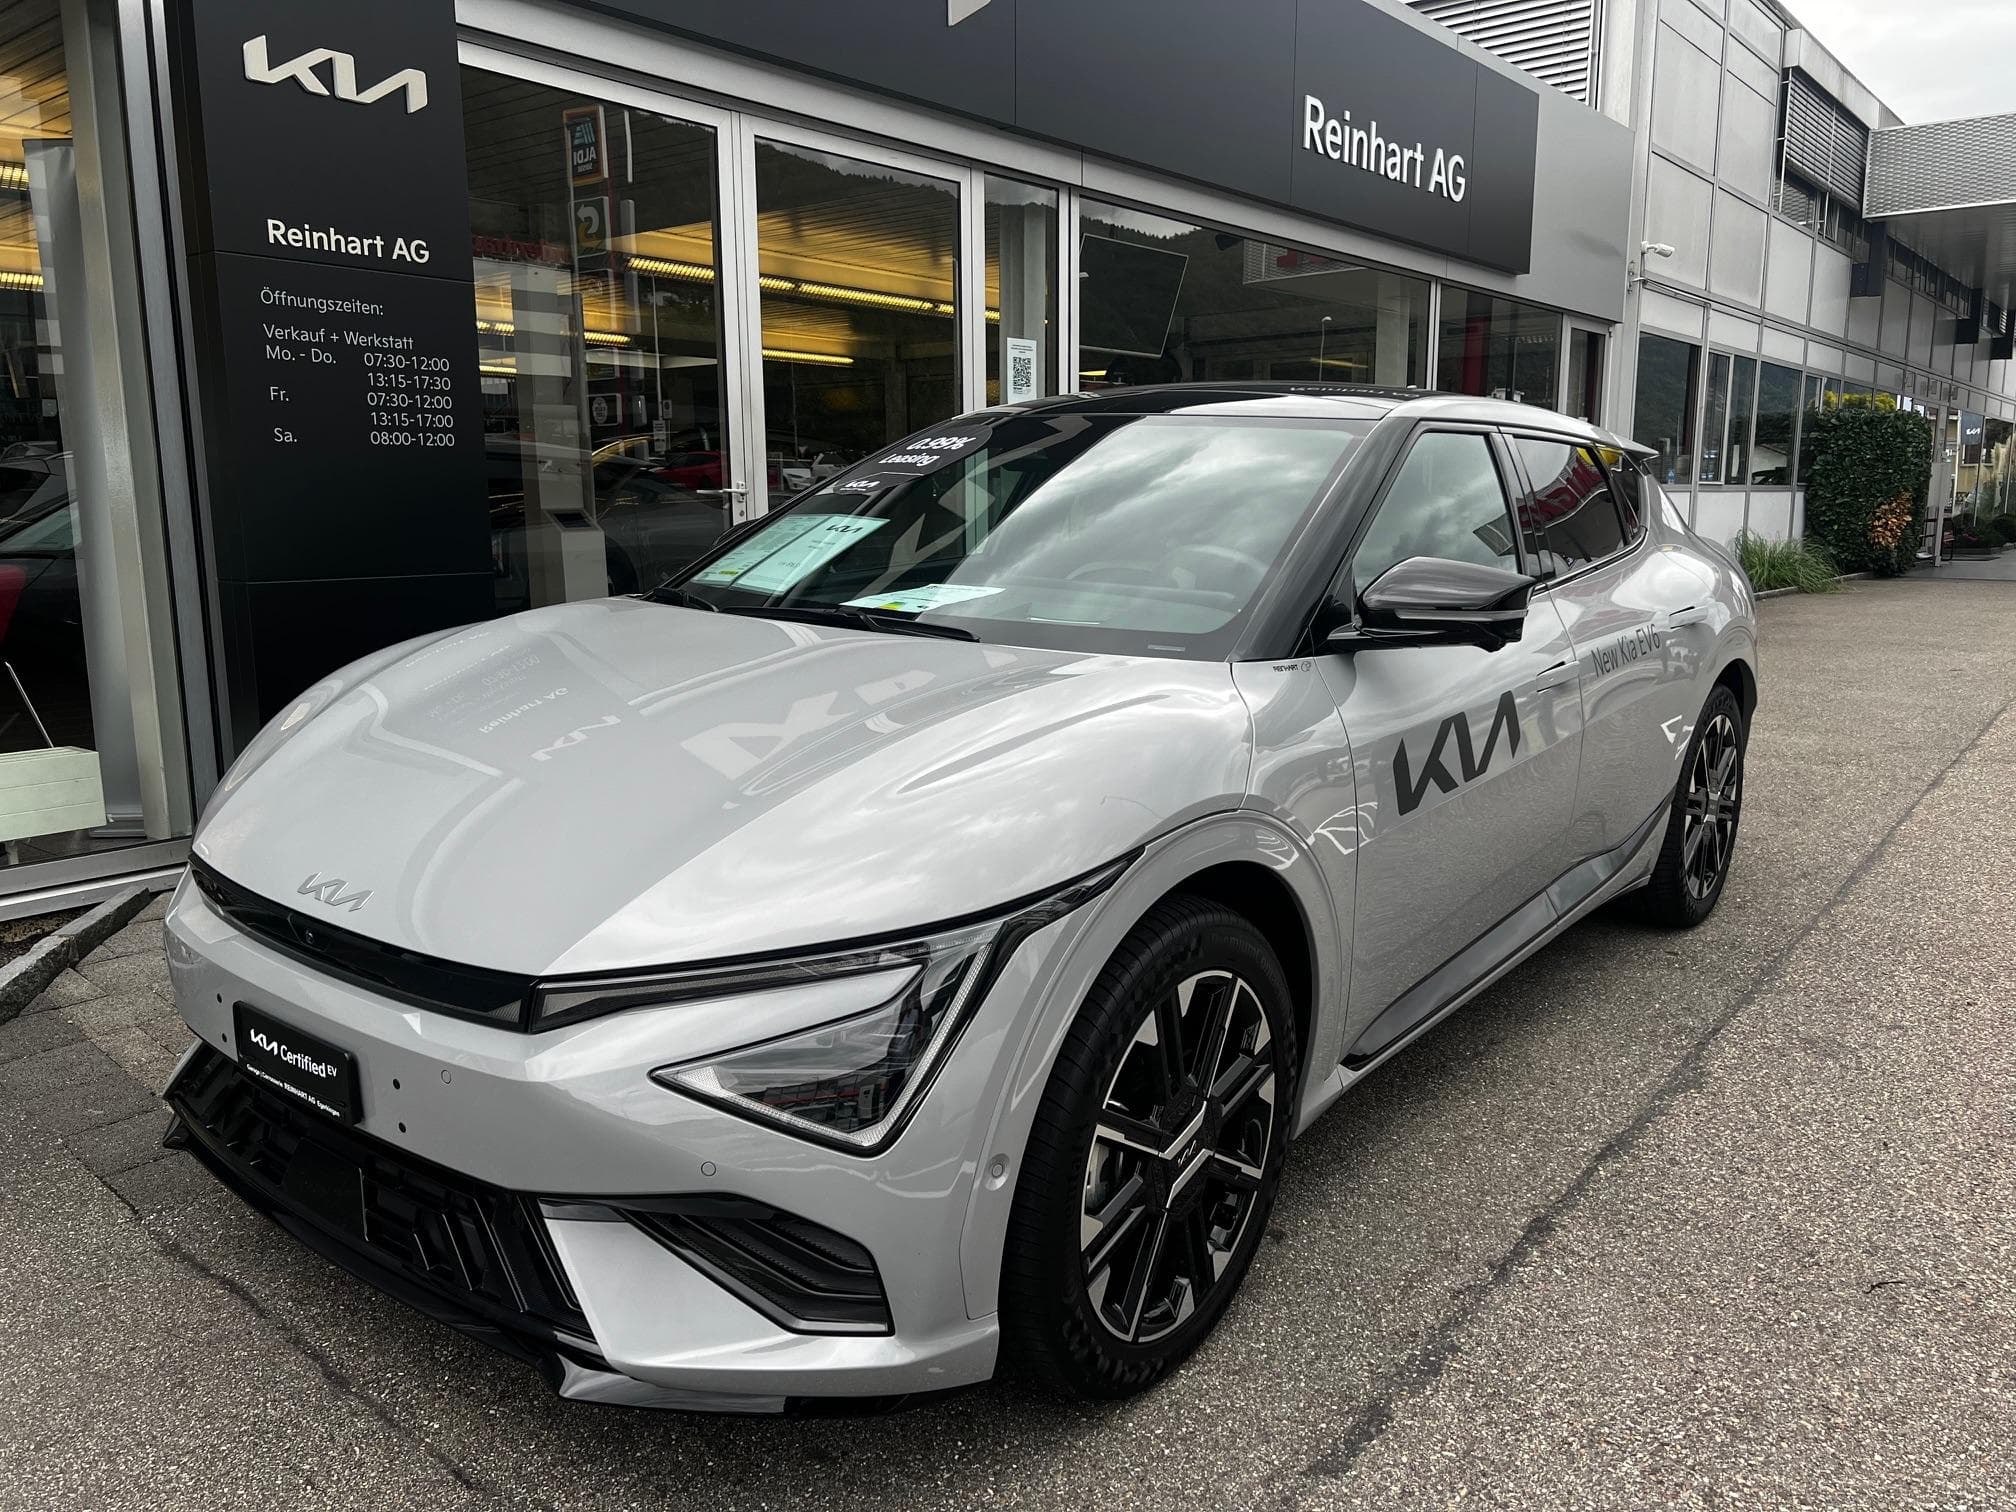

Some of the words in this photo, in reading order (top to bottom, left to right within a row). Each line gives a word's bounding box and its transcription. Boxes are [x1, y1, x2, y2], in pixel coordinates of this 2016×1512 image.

[1302, 94, 1425, 188] Reinhart
[1427, 147, 1466, 202] AG
[267, 218, 385, 258] Reinhart
[391, 237, 430, 263] AG
[260, 286, 384, 316] Öffnungszeiten:
[263, 323, 325, 343] Verkauf
[330, 332, 339, 343] +
[343, 330, 414, 350] Werkstatt
[266, 345, 296, 361] Mo.
[311, 348, 337, 364] Do.
[364, 353, 450, 372] 07:30-12:00
[367, 372, 451, 390] 13:15-17:30
[270, 386, 289, 402] Fr.
[367, 392, 452, 409] 07:30-12:00
[370, 411, 454, 428] 13:15-17:00
[274, 427, 298, 443] Sa.
[370, 431, 455, 447] 08:00-12:00
[906, 437, 977, 450] 0.99%
[878, 453, 940, 467] Leasing
[1591, 647, 1618, 678] New
[1617, 635, 1637, 665] Kia
[1635, 623, 1660, 656] EV6
[280, 1045, 326, 1078] Certified
[327, 1064, 337, 1077] EV
